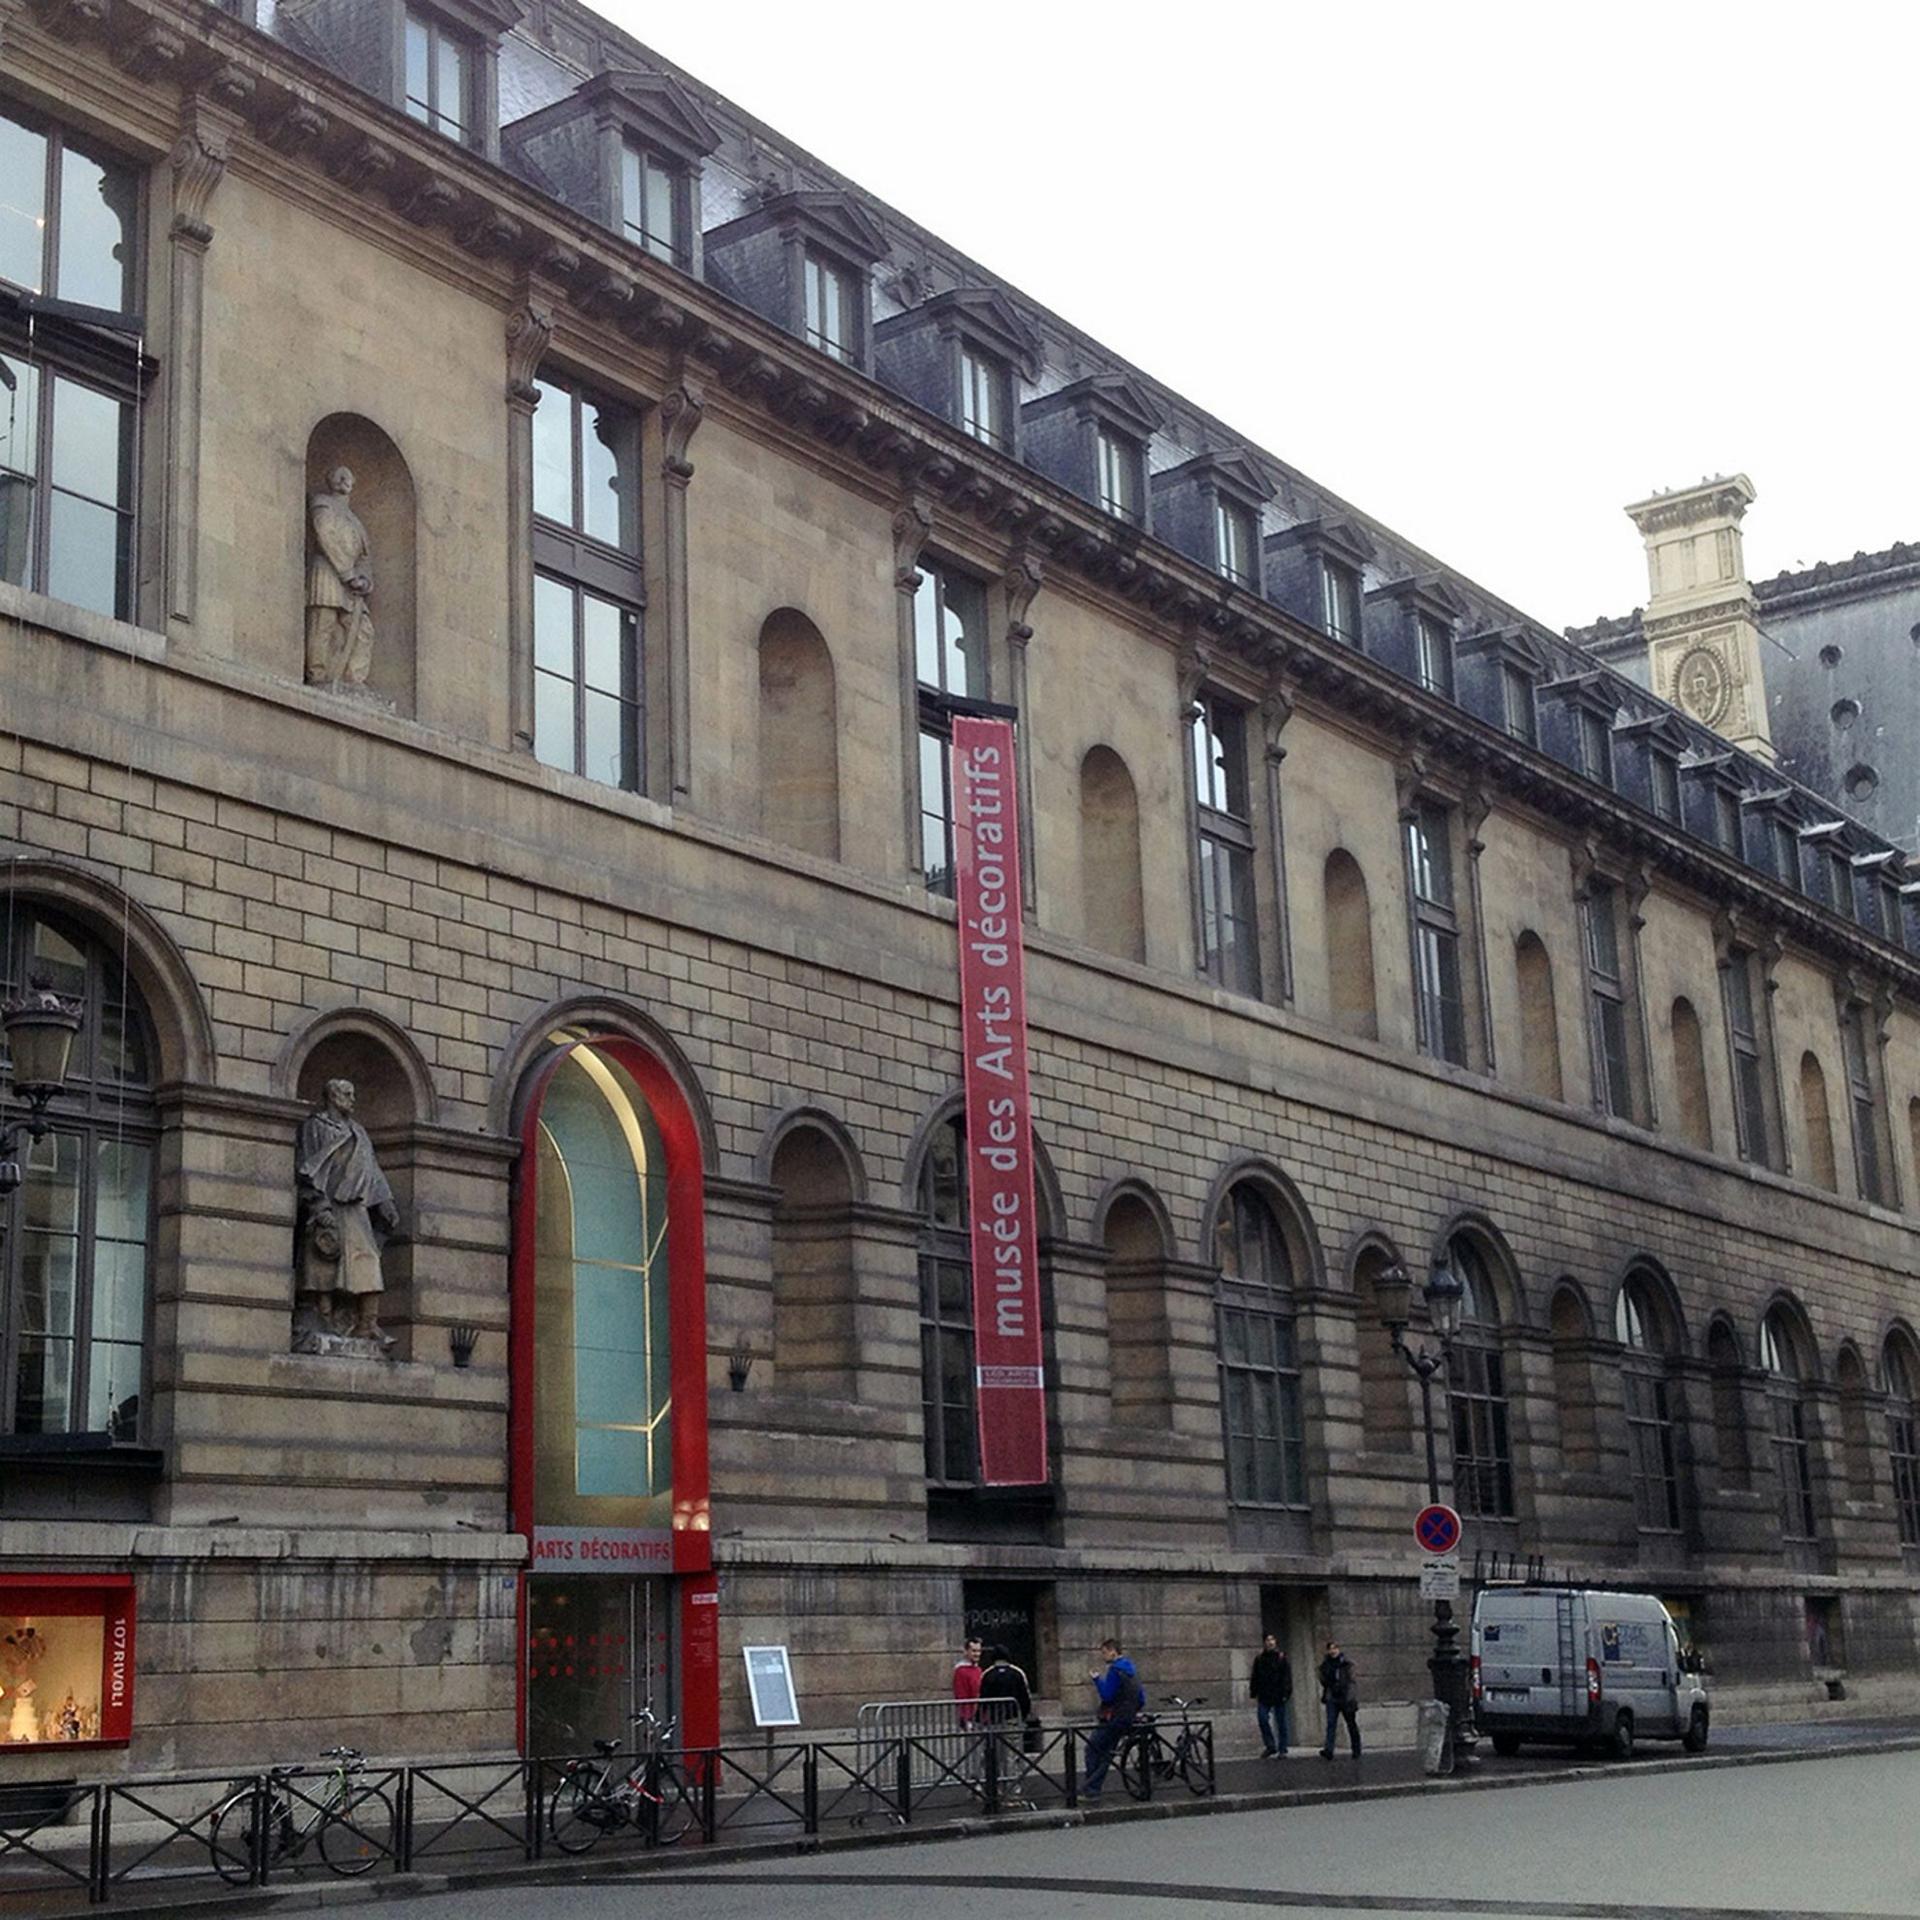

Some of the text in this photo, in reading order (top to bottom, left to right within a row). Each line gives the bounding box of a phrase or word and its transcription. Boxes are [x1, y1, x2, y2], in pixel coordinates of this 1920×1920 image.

[962, 745, 1009, 967] décoratifs
[976, 986, 1014, 1081] Arts
[980, 1097, 1017, 1172] des
[980, 1192, 1025, 1338] musée
[534, 1537, 671, 1560] ARTS DÉCORATIFS
